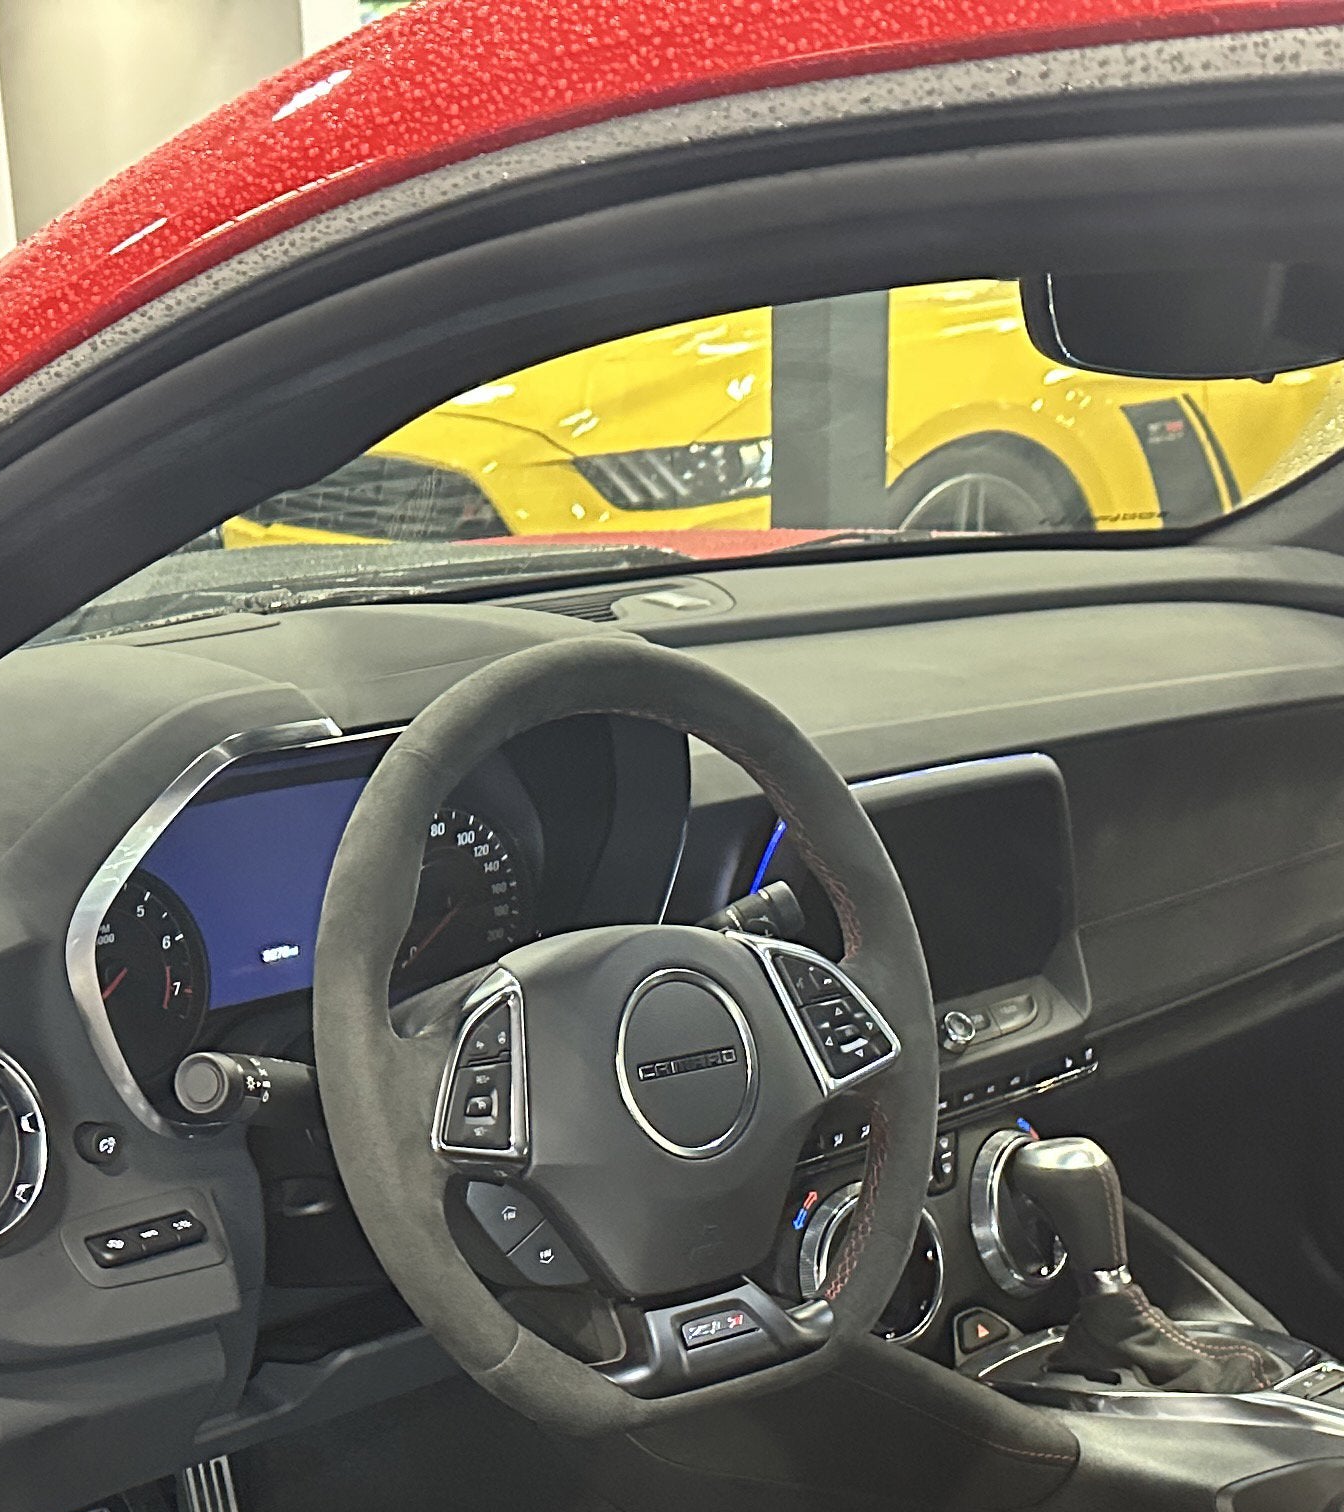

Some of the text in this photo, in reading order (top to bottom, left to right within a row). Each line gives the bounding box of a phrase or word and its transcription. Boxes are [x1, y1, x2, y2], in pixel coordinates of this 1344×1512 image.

[430, 822, 445, 837] 80
[456, 830, 475, 846] 100
[473, 843, 490, 858] 120
[483, 860, 500, 874] 140
[136, 904, 145, 918] 5
[162, 935, 171, 949] 6
[173, 981, 181, 996] 7
